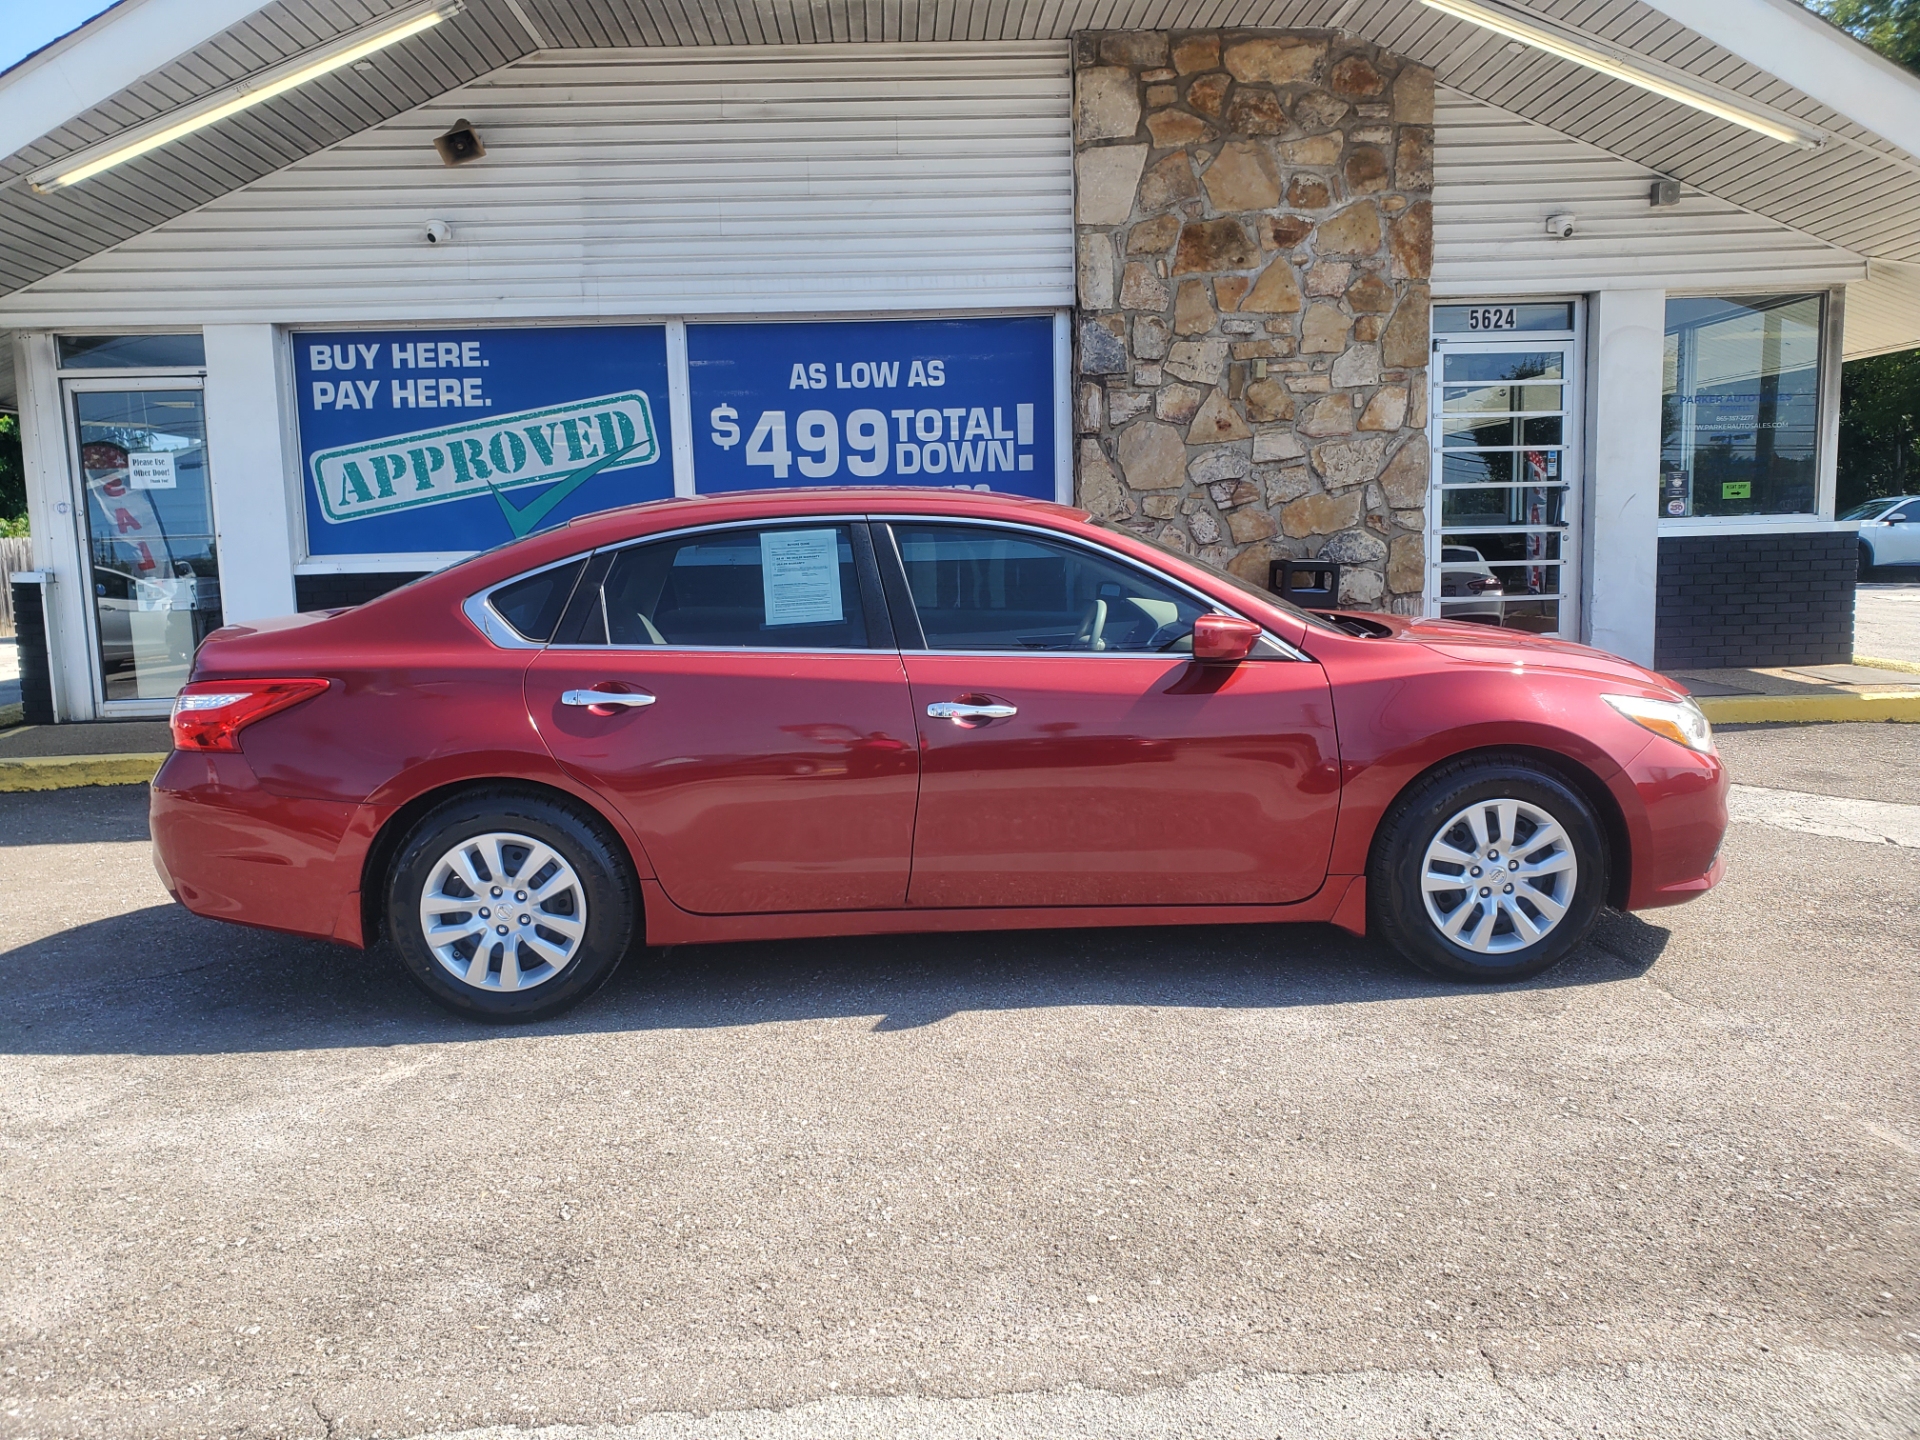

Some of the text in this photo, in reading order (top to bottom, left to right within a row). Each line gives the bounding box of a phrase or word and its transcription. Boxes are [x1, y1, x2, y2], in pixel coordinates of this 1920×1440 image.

[1470, 308, 1515, 329] 5624
[309, 341, 490, 371] BUY HERE.
[789, 360, 946, 389] AS LOW AS
[312, 378, 492, 410] PAY HERE.
[1680, 395, 1722, 404] PARKER
[1726, 394, 1757, 403] AUTO
[891, 406, 1014, 442] TOTAL
[710, 403, 890, 479] $499
[132, 458, 166, 467] Please Use
[133, 468, 170, 477] Other Door!
[338, 410, 637, 507] APPROVED
